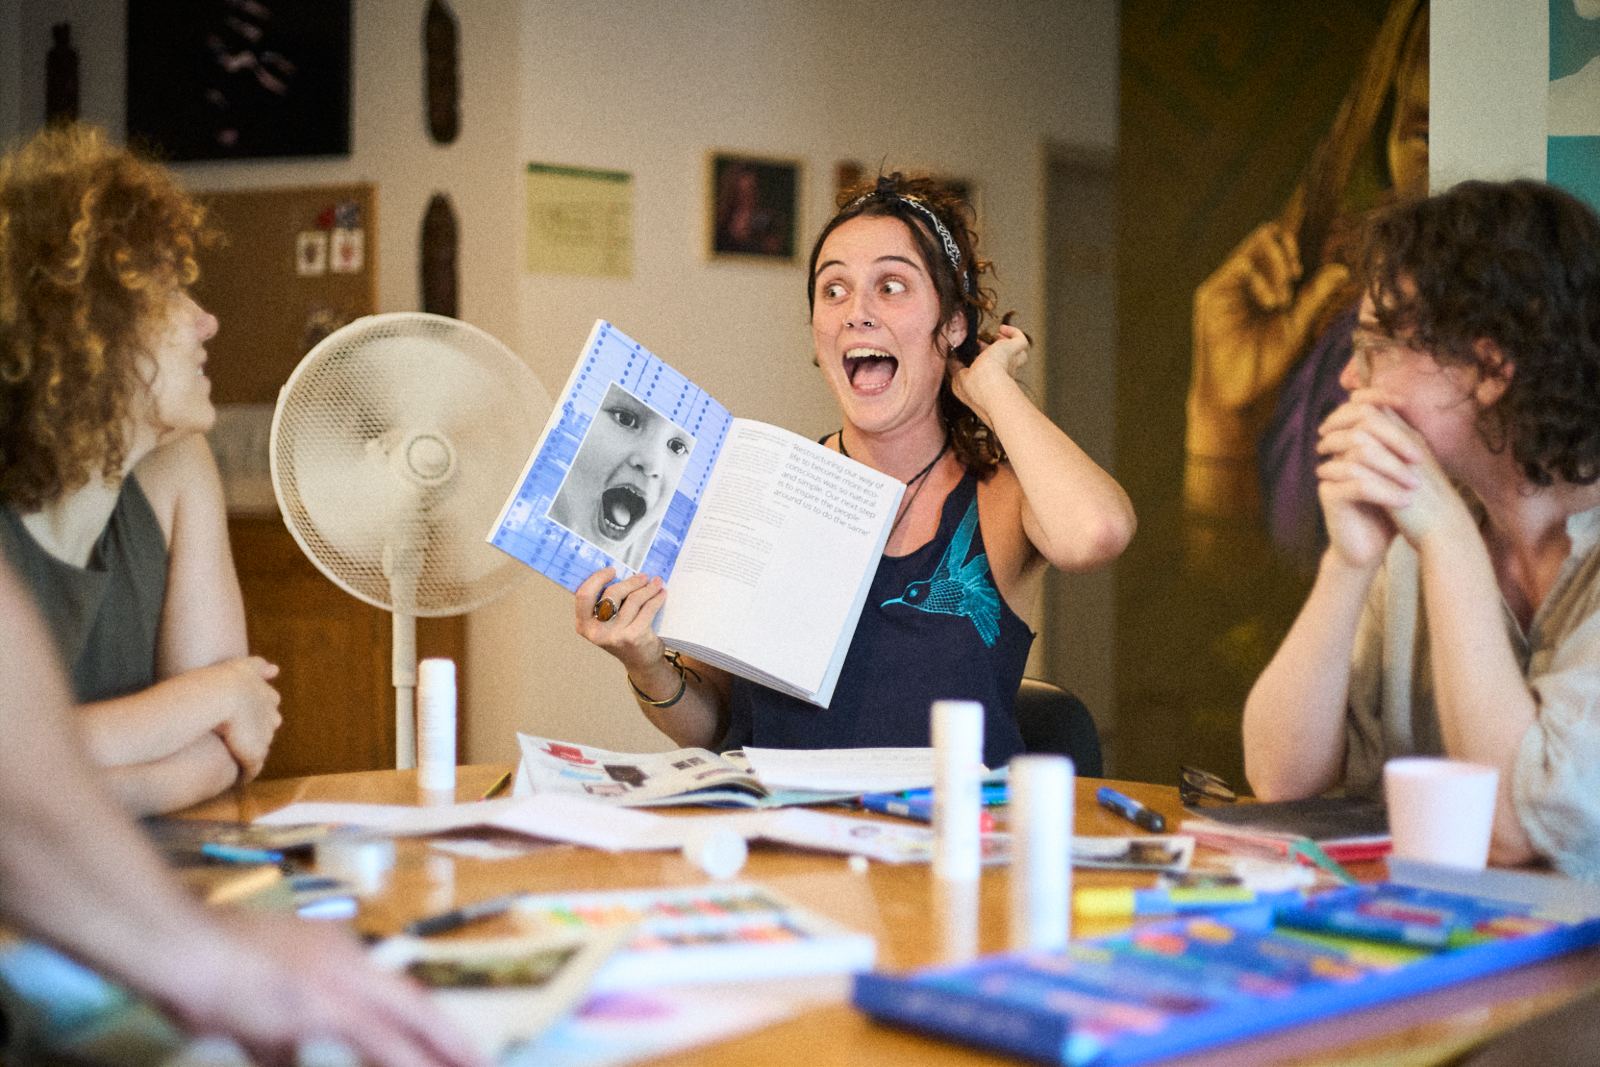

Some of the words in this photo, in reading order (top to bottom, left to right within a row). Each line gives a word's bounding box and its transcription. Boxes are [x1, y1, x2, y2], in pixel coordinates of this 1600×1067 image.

[785, 462, 821, 482] conscious
[823, 480, 837, 489] was
[840, 487, 847, 495] so
[850, 491, 877, 507] natural
[790, 453, 800, 462] life
[802, 458, 810, 466] to
[811, 462, 841, 480] become
[842, 478, 862, 491] more
[793, 444, 843, 473] Restructuring
[845, 469, 858, 479] our
[859, 475, 874, 487] way
[875, 481, 884, 489] of
[773, 489, 802, 505] around
[803, 502, 812, 510] us
[813, 506, 821, 514] to
[822, 511, 832, 520] do
[834, 516, 846, 525] the
[781, 472, 797, 481] and
[825, 490, 840, 501] Our
[841, 498, 858, 510] next
[859, 505, 876, 518] step
[786, 482, 793, 490] to
[795, 488, 820, 502] inspire
[821, 499, 833, 508] the
[834, 506, 859, 520] people
